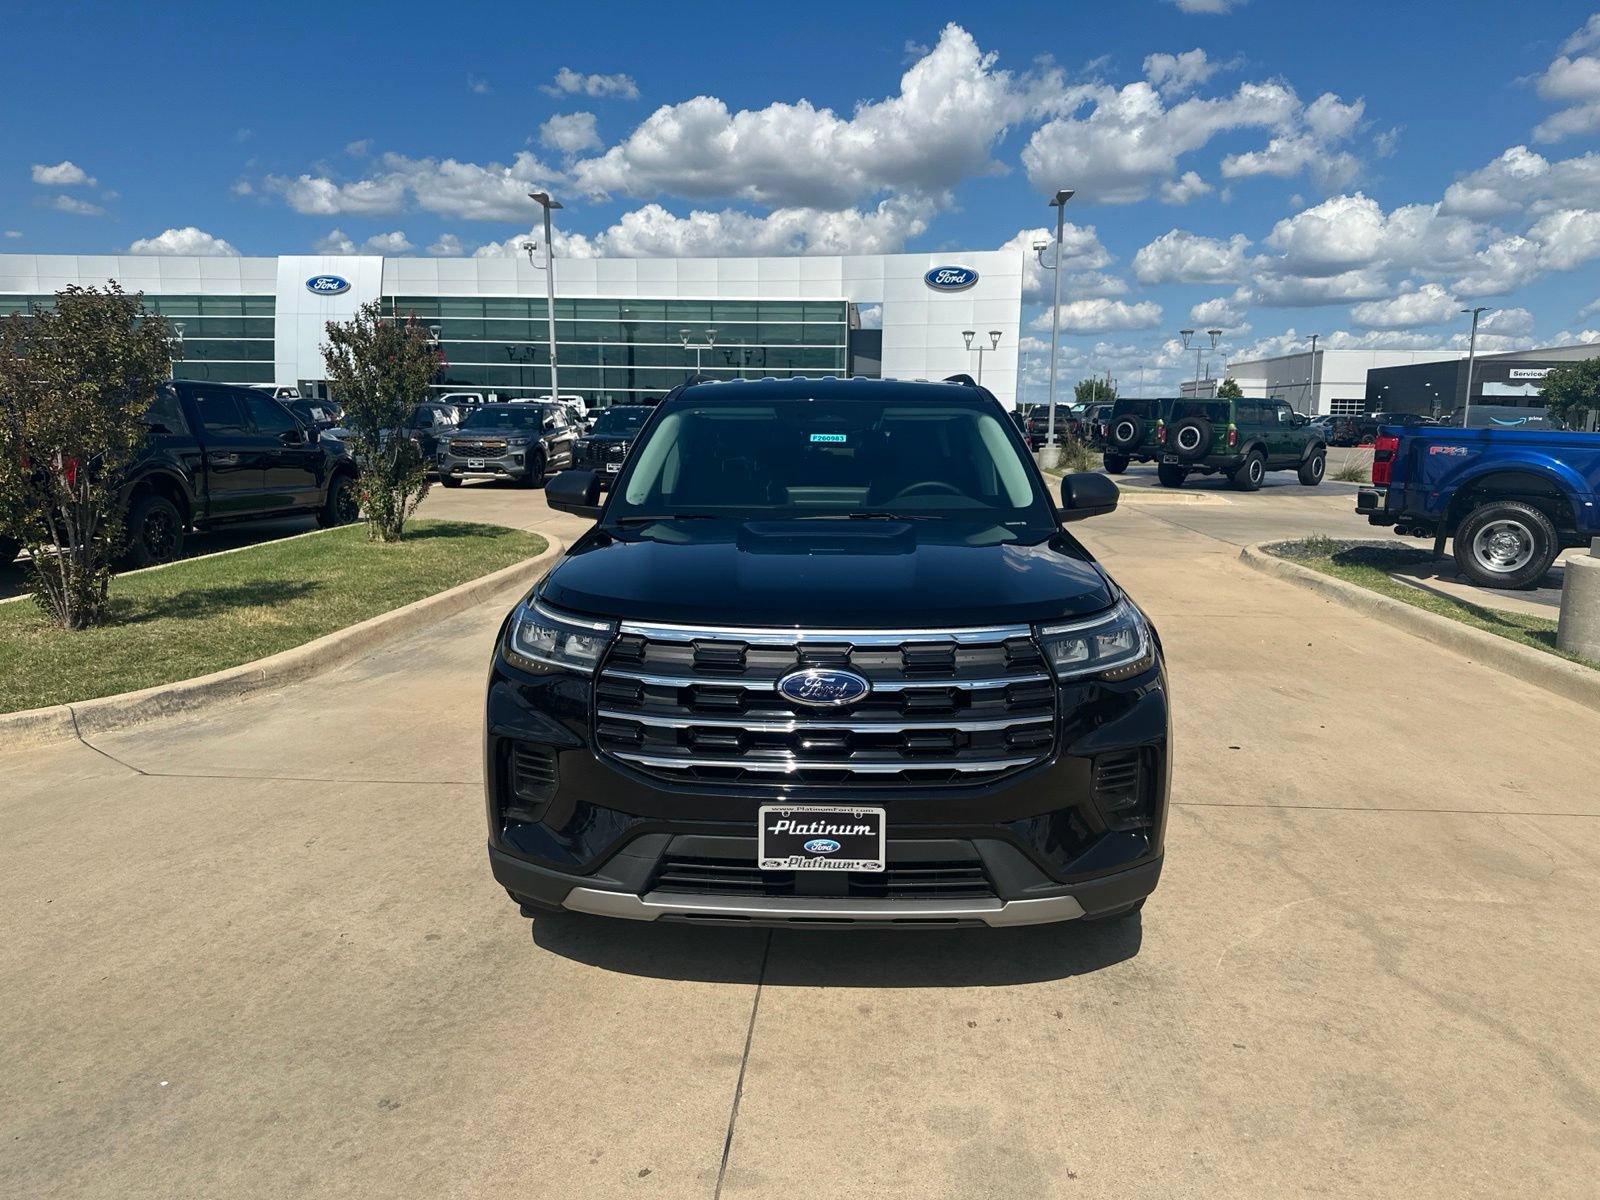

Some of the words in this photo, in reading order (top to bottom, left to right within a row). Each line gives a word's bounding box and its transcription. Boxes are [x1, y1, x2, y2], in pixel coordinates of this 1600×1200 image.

[936, 270, 967, 283] Ford
[314, 278, 340, 290] Ford
[1430, 446, 1467, 456] FX4
[800, 676, 848, 698] Ford
[768, 820, 876, 835] Platinum
[811, 841, 833, 851] Ford
[788, 857, 858, 869] Platinum
